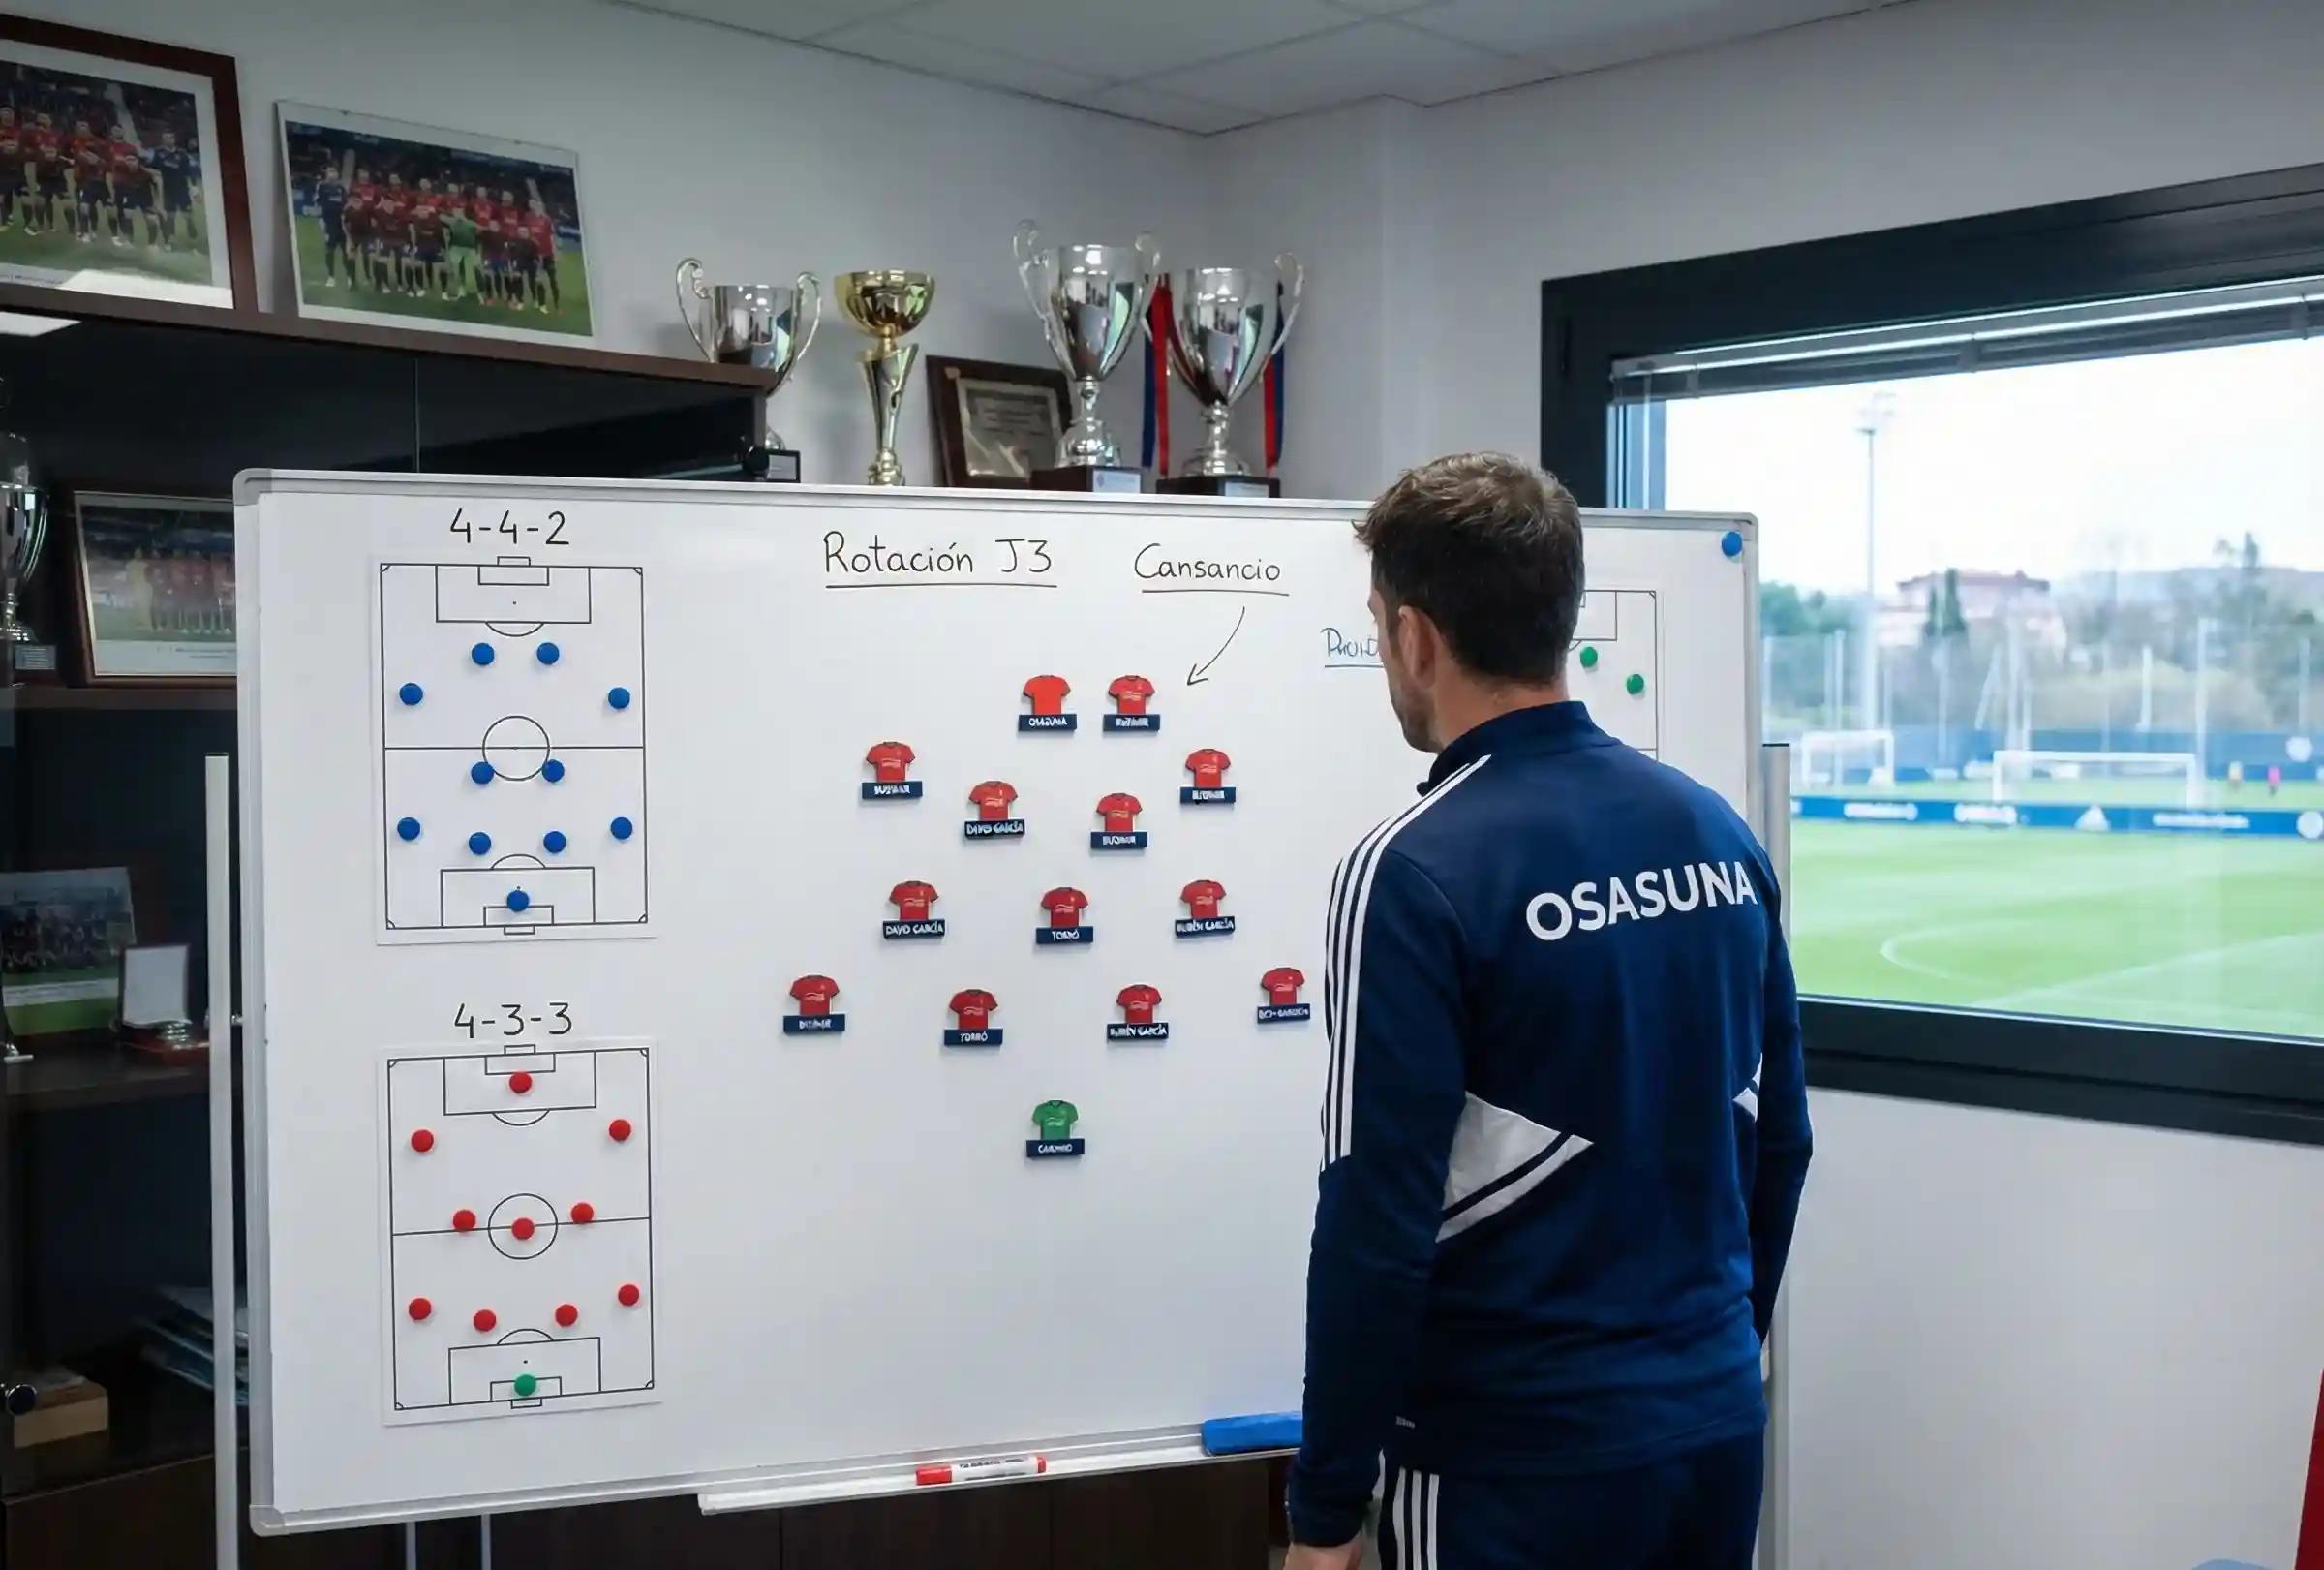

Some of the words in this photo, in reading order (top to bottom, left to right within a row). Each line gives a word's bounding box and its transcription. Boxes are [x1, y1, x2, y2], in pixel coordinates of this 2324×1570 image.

[450, 508, 569, 545] 4-4-2
[823, 530, 974, 574] Rotación
[994, 538, 1053, 573] J3
[1133, 542, 1281, 581] Cansancio
[1525, 860, 1758, 941] OSASUNA
[454, 1002, 572, 1039] 4-3-3
